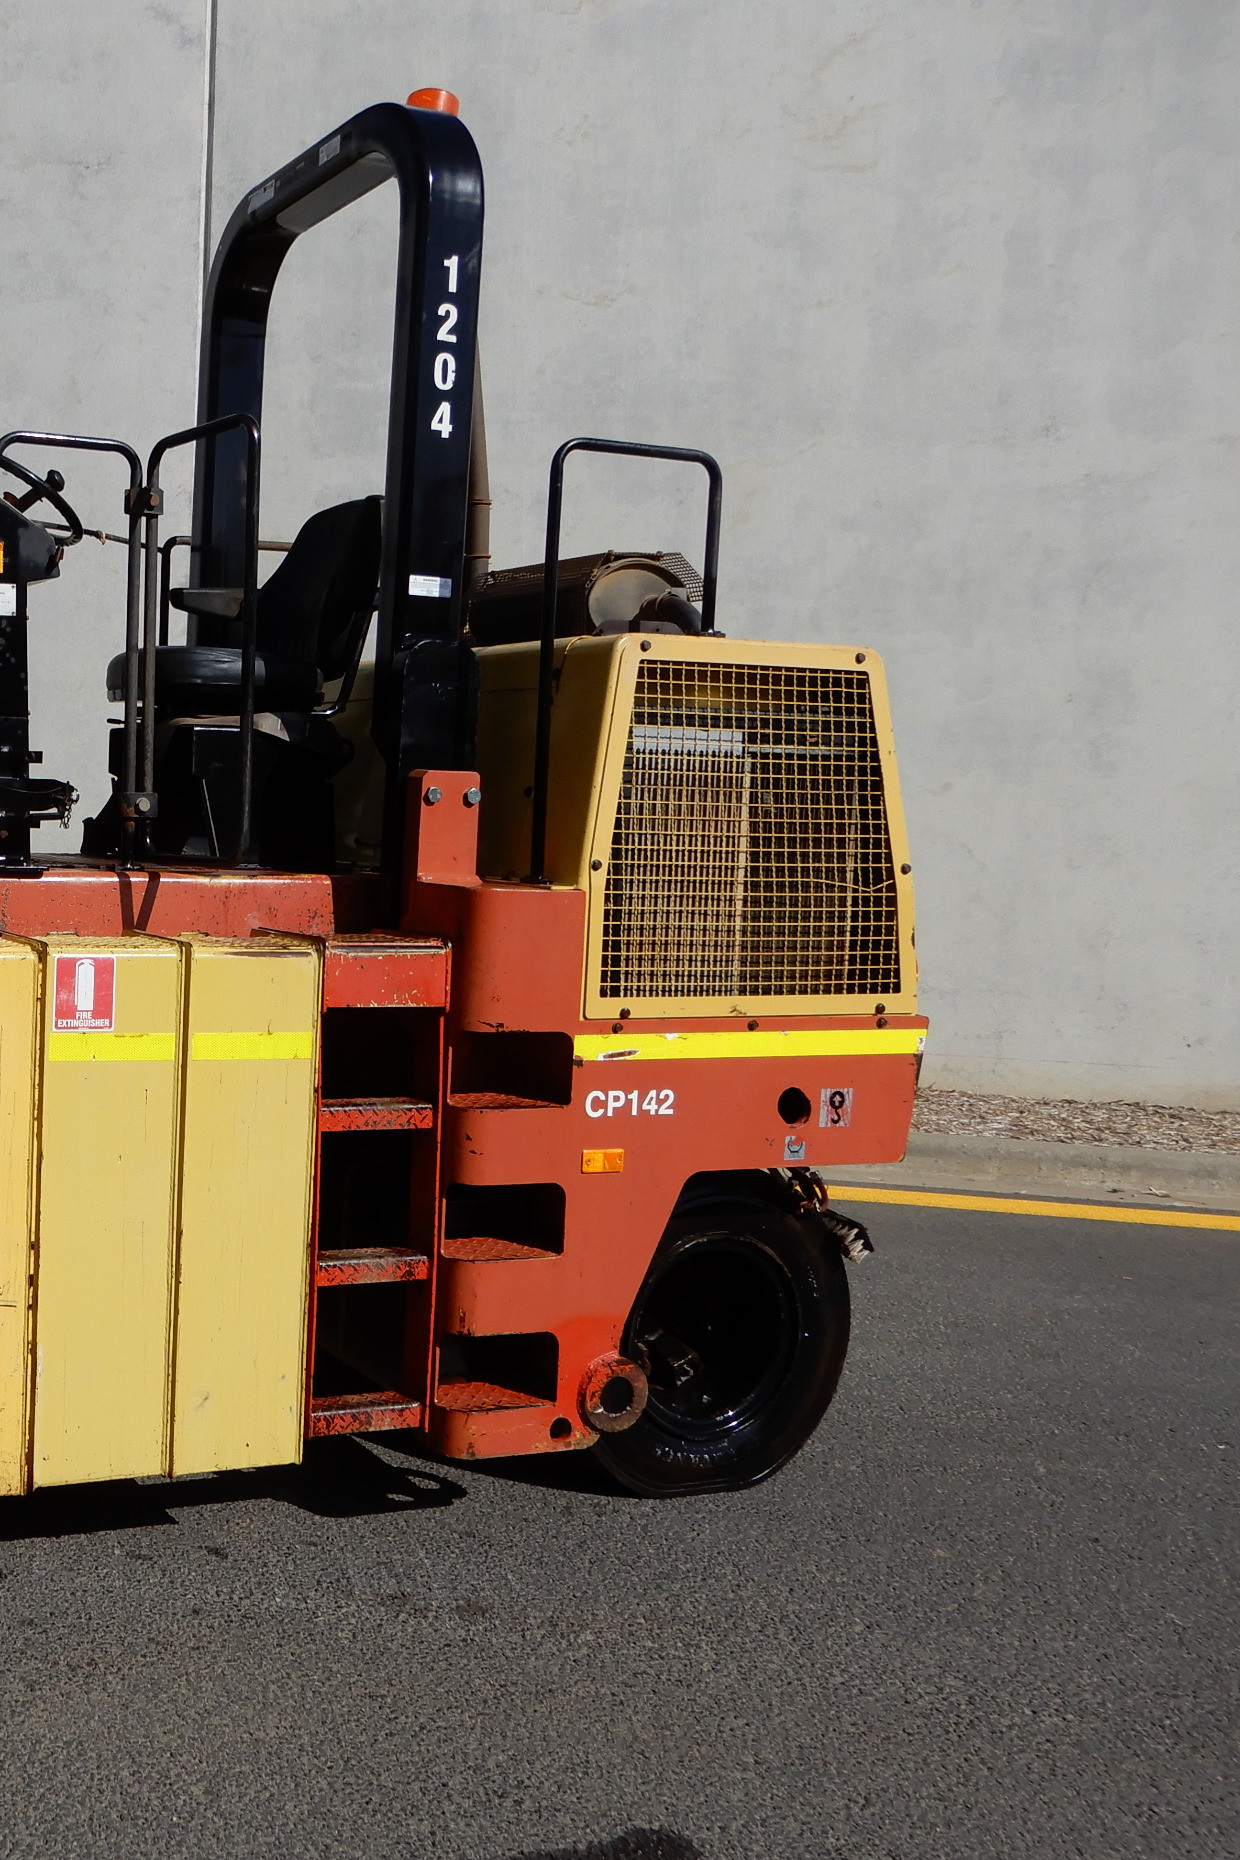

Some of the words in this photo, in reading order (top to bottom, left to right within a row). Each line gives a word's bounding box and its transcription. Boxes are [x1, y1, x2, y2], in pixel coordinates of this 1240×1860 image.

[430, 255, 459, 438] 1204
[58, 1019, 109, 1027] EXTINGUISHER
[76, 1011, 92, 1019] FIRE
[584, 1088, 675, 1118] CP142
